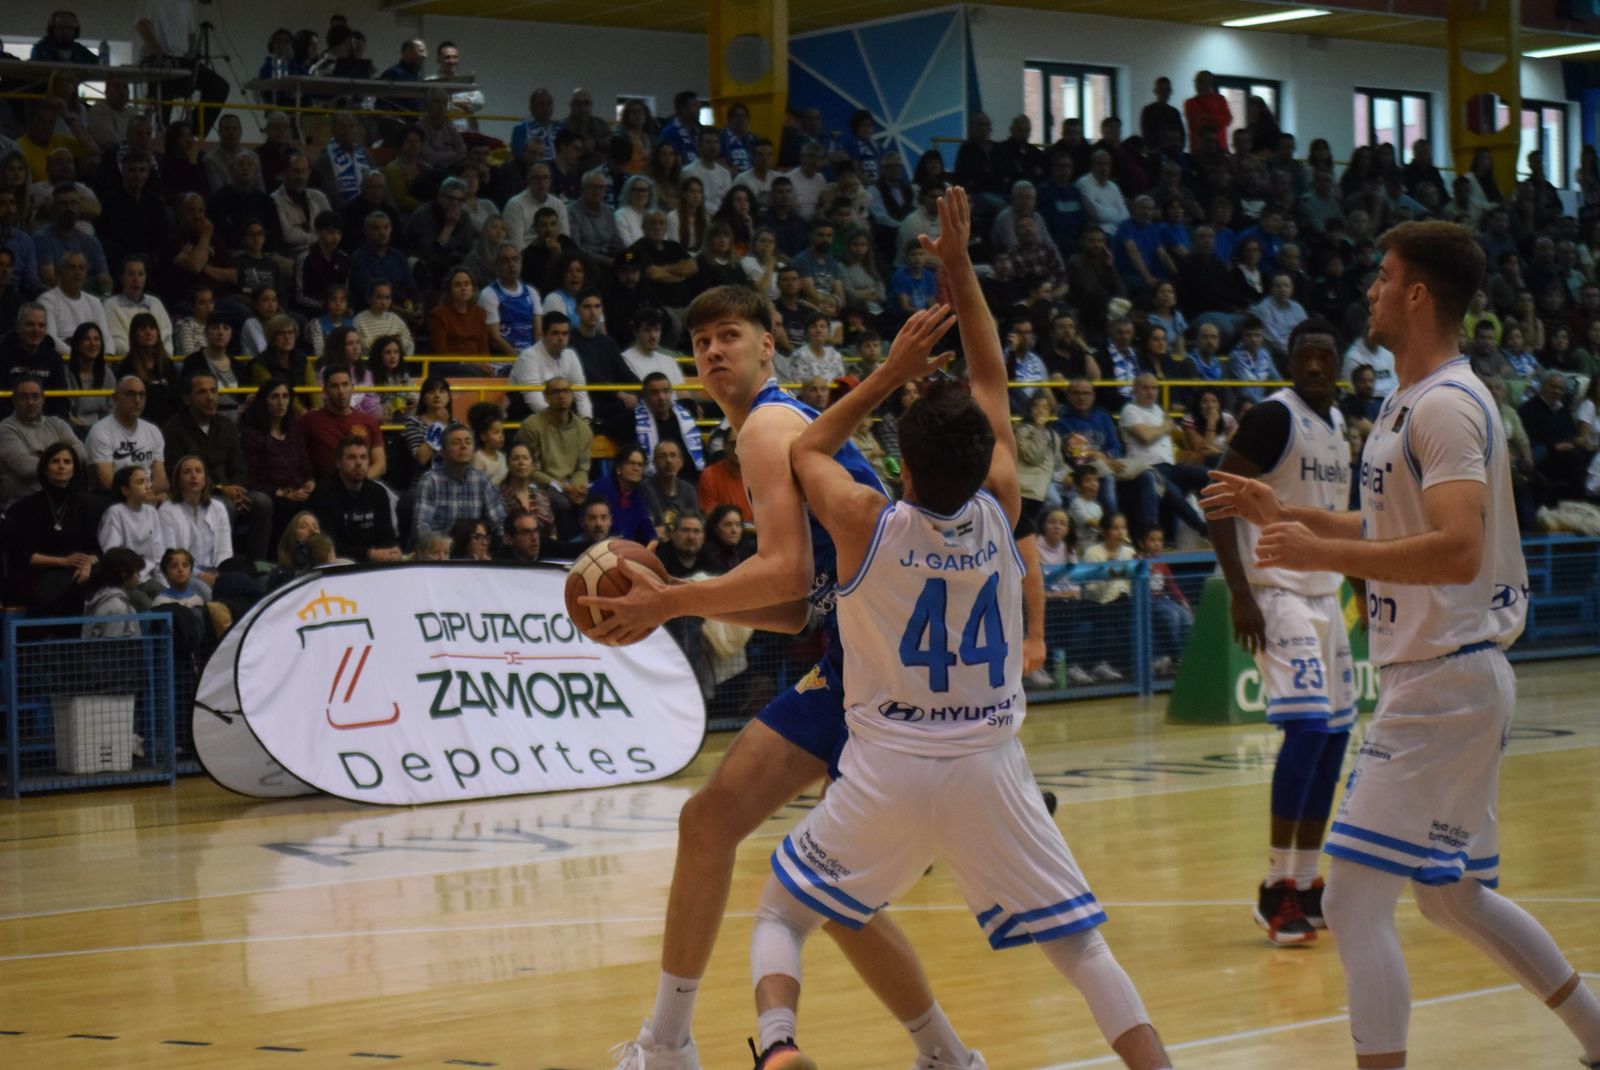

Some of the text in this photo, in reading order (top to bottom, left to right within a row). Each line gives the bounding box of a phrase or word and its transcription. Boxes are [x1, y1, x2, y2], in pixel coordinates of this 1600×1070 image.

[900, 549, 919, 567] J.
[898, 570, 1009, 693] 44
[1290, 657, 1324, 689] 23
[415, 669, 634, 719] ZAMORA
[930, 694, 1018, 721] HYUN
[338, 742, 657, 790] Deportes
